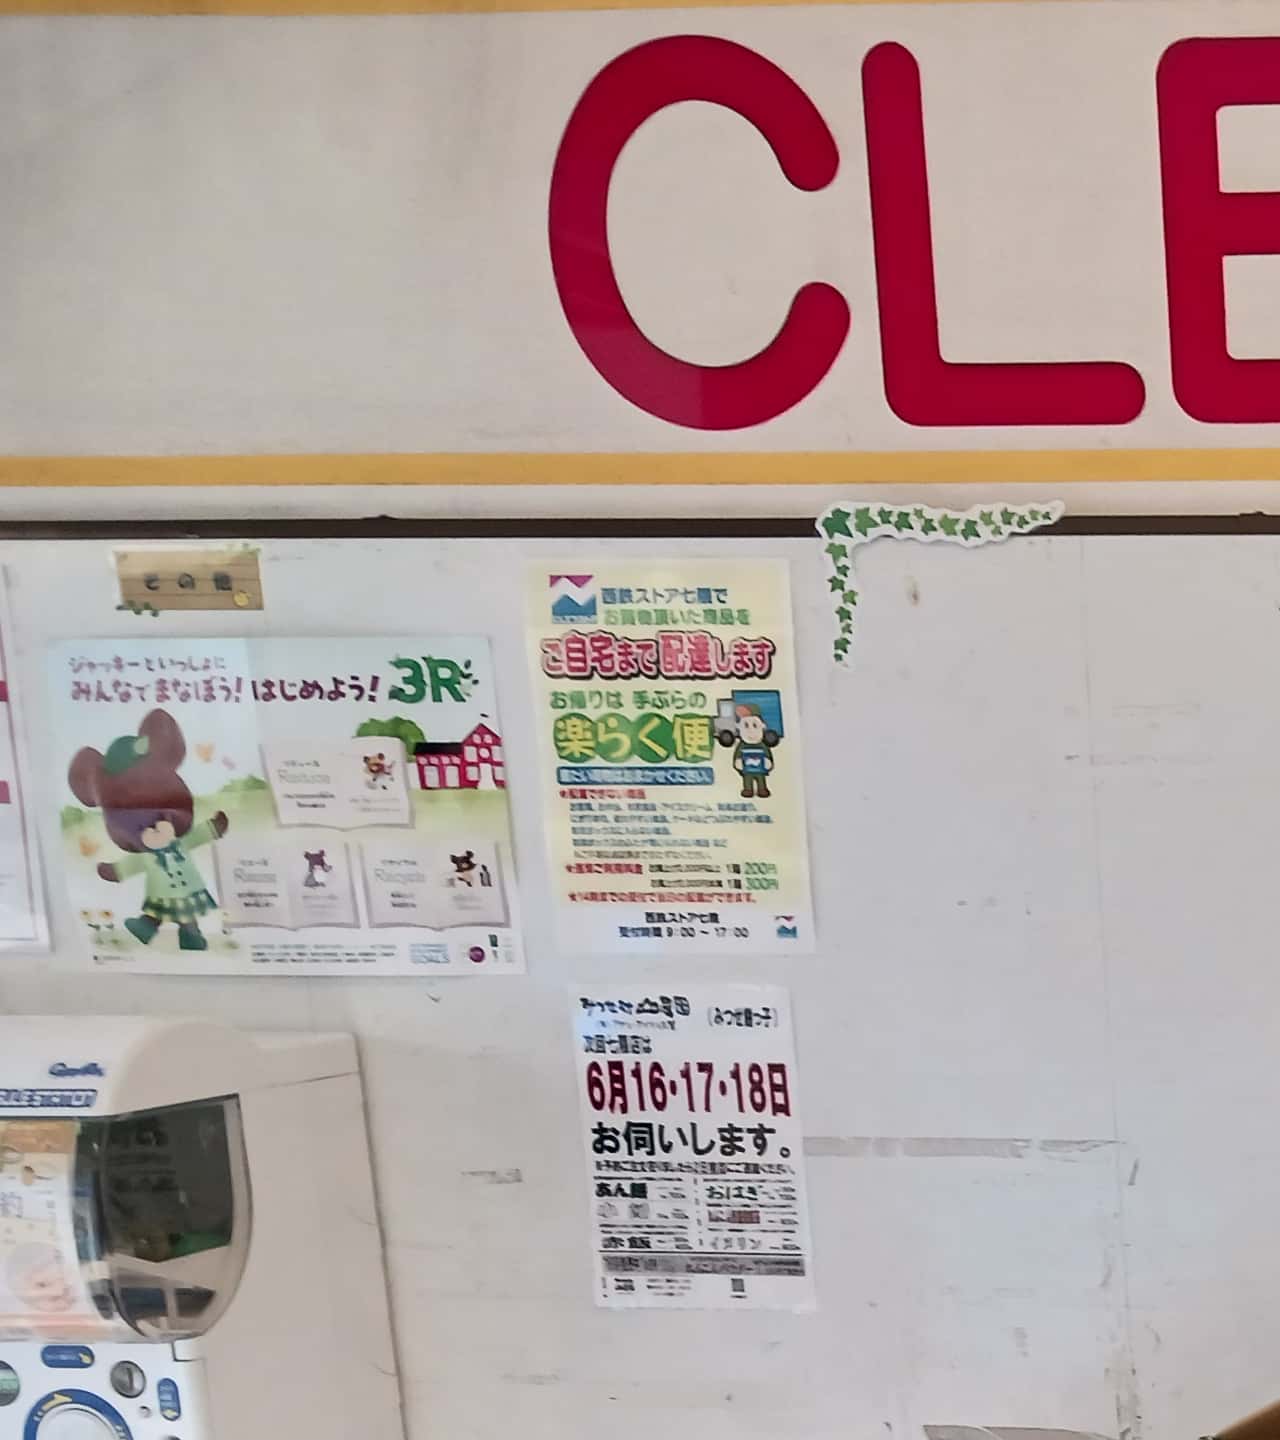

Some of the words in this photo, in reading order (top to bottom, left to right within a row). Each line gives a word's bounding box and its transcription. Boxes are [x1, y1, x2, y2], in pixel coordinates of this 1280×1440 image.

[542, 631, 775, 677] ご自宅まで配達します
[388, 655, 468, 704] 3R
[631, 689, 708, 709] 手ぶらの
[554, 713, 714, 762] 楽らく便
[586, 1060, 792, 1117] 6月16・17・18日
[590, 1120, 792, 1159] お伺いします。
